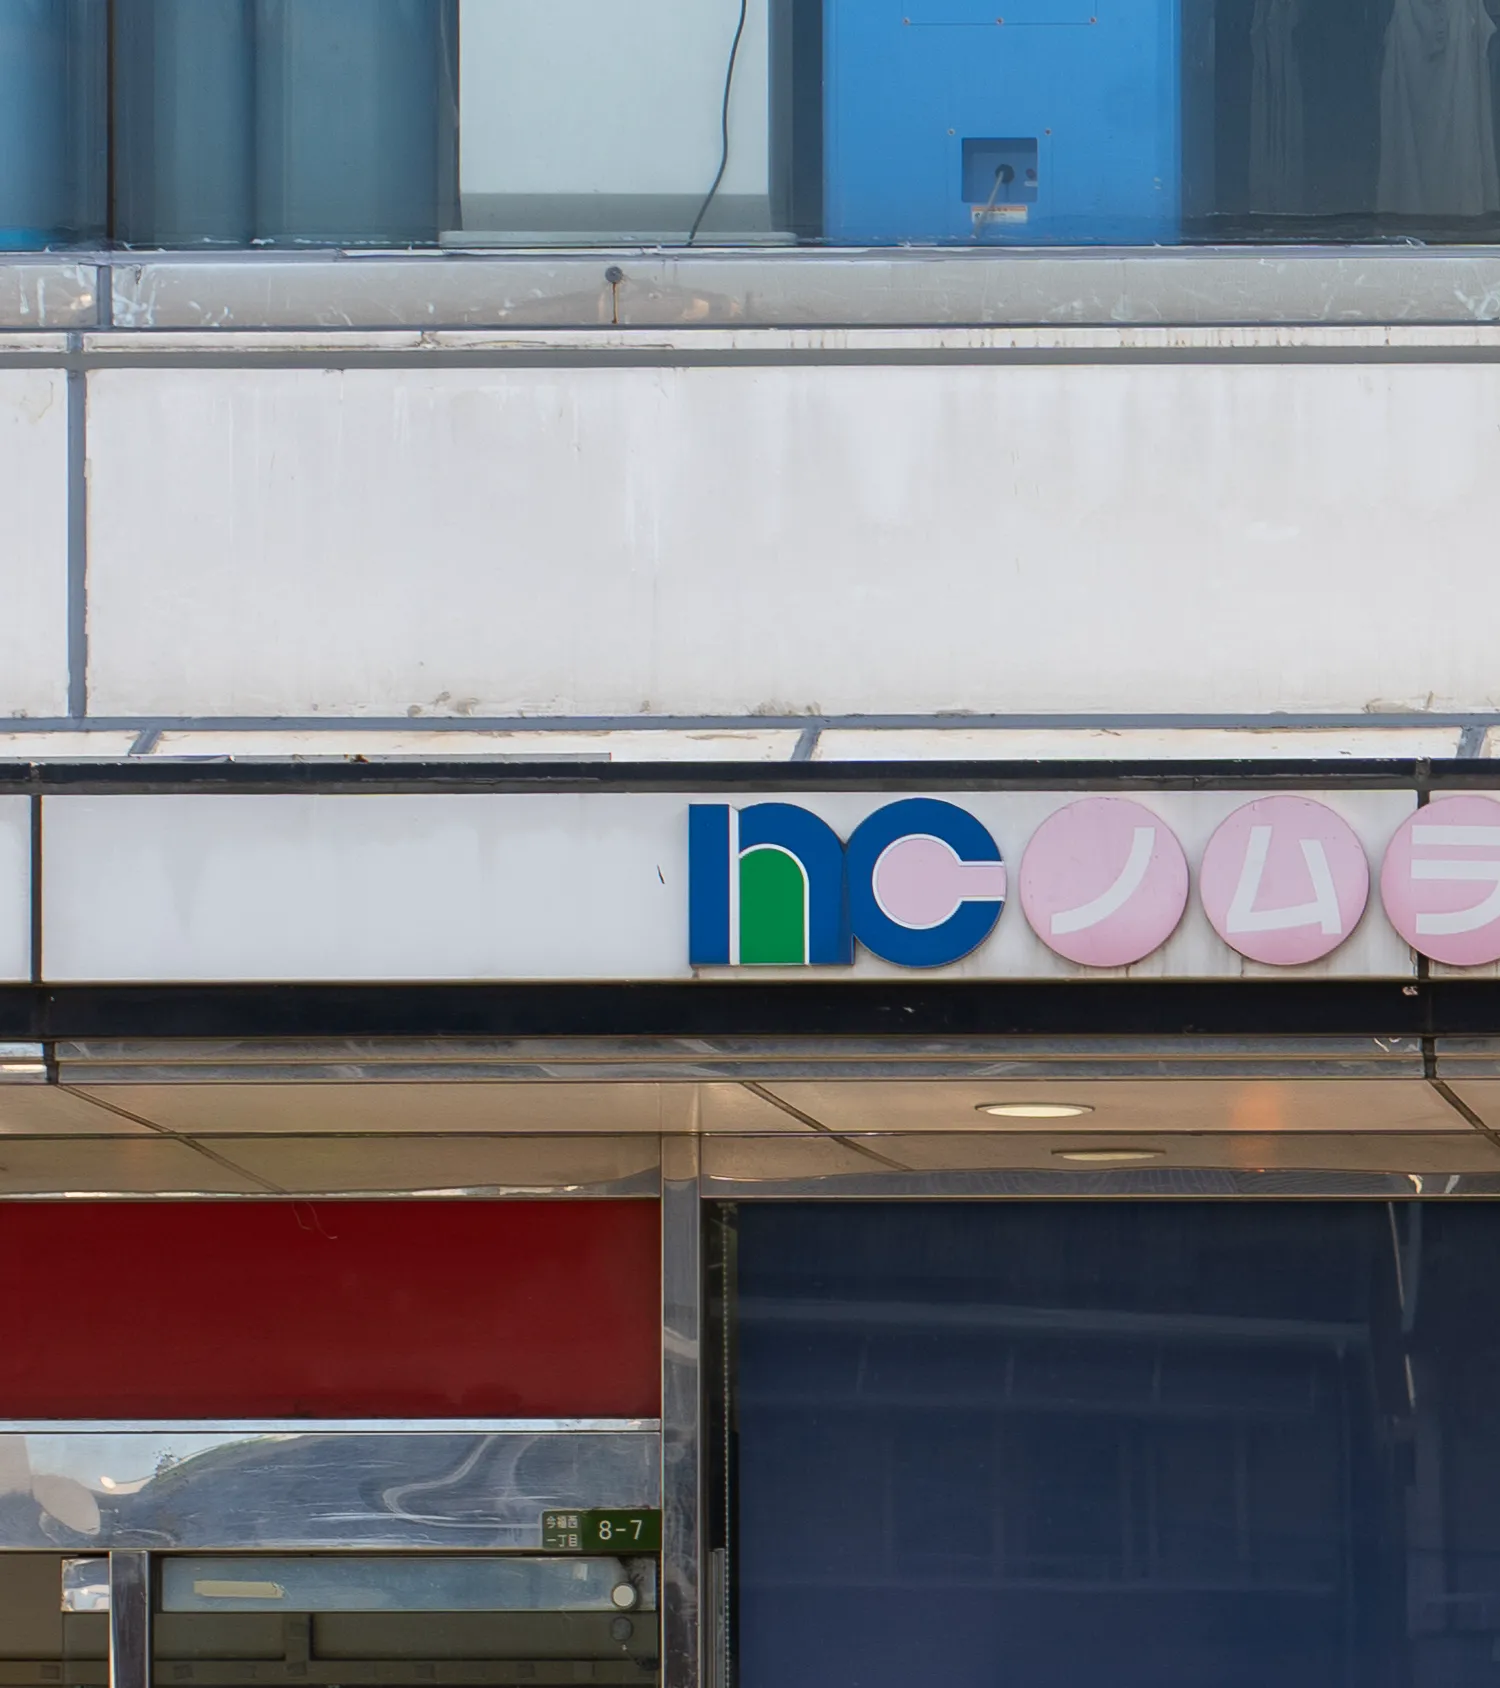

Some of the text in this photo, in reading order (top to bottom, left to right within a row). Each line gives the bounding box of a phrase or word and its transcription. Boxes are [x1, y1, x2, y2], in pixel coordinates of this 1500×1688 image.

[599, 1520, 642, 1540] 8-7
[547, 1534, 578, 1547] 一丁目
